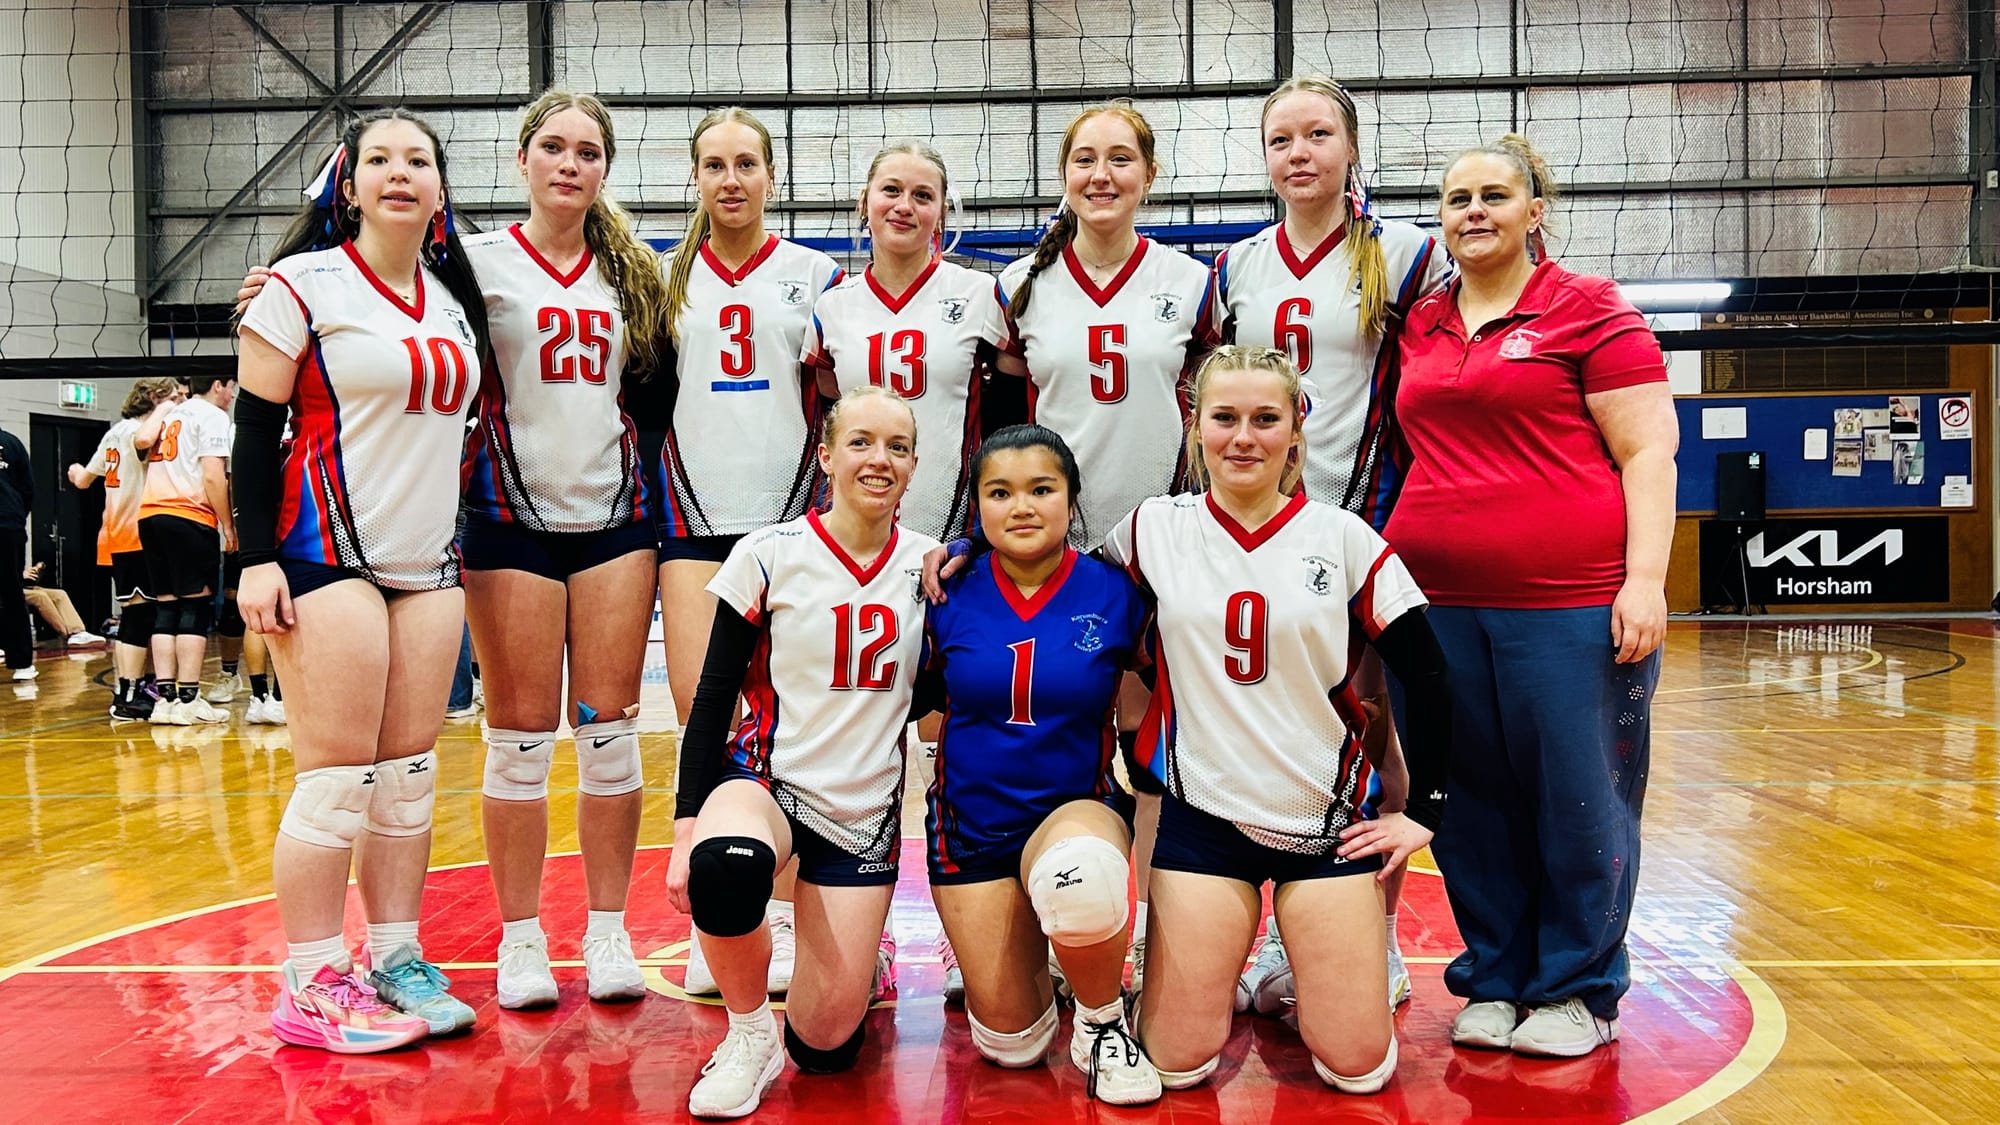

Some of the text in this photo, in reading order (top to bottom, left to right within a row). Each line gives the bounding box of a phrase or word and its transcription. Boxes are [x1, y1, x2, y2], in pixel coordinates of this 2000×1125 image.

[400, 336, 469, 416] 10
[536, 306, 614, 386] 25
[719, 304, 755, 378] 3
[865, 329, 927, 400] 13
[1087, 324, 1128, 404] 5
[1273, 297, 1313, 375] 6
[1777, 577, 1872, 595] Horsham
[829, 602, 899, 691] 12
[1223, 591, 1268, 685] 9
[1006, 637, 1037, 726] 1
